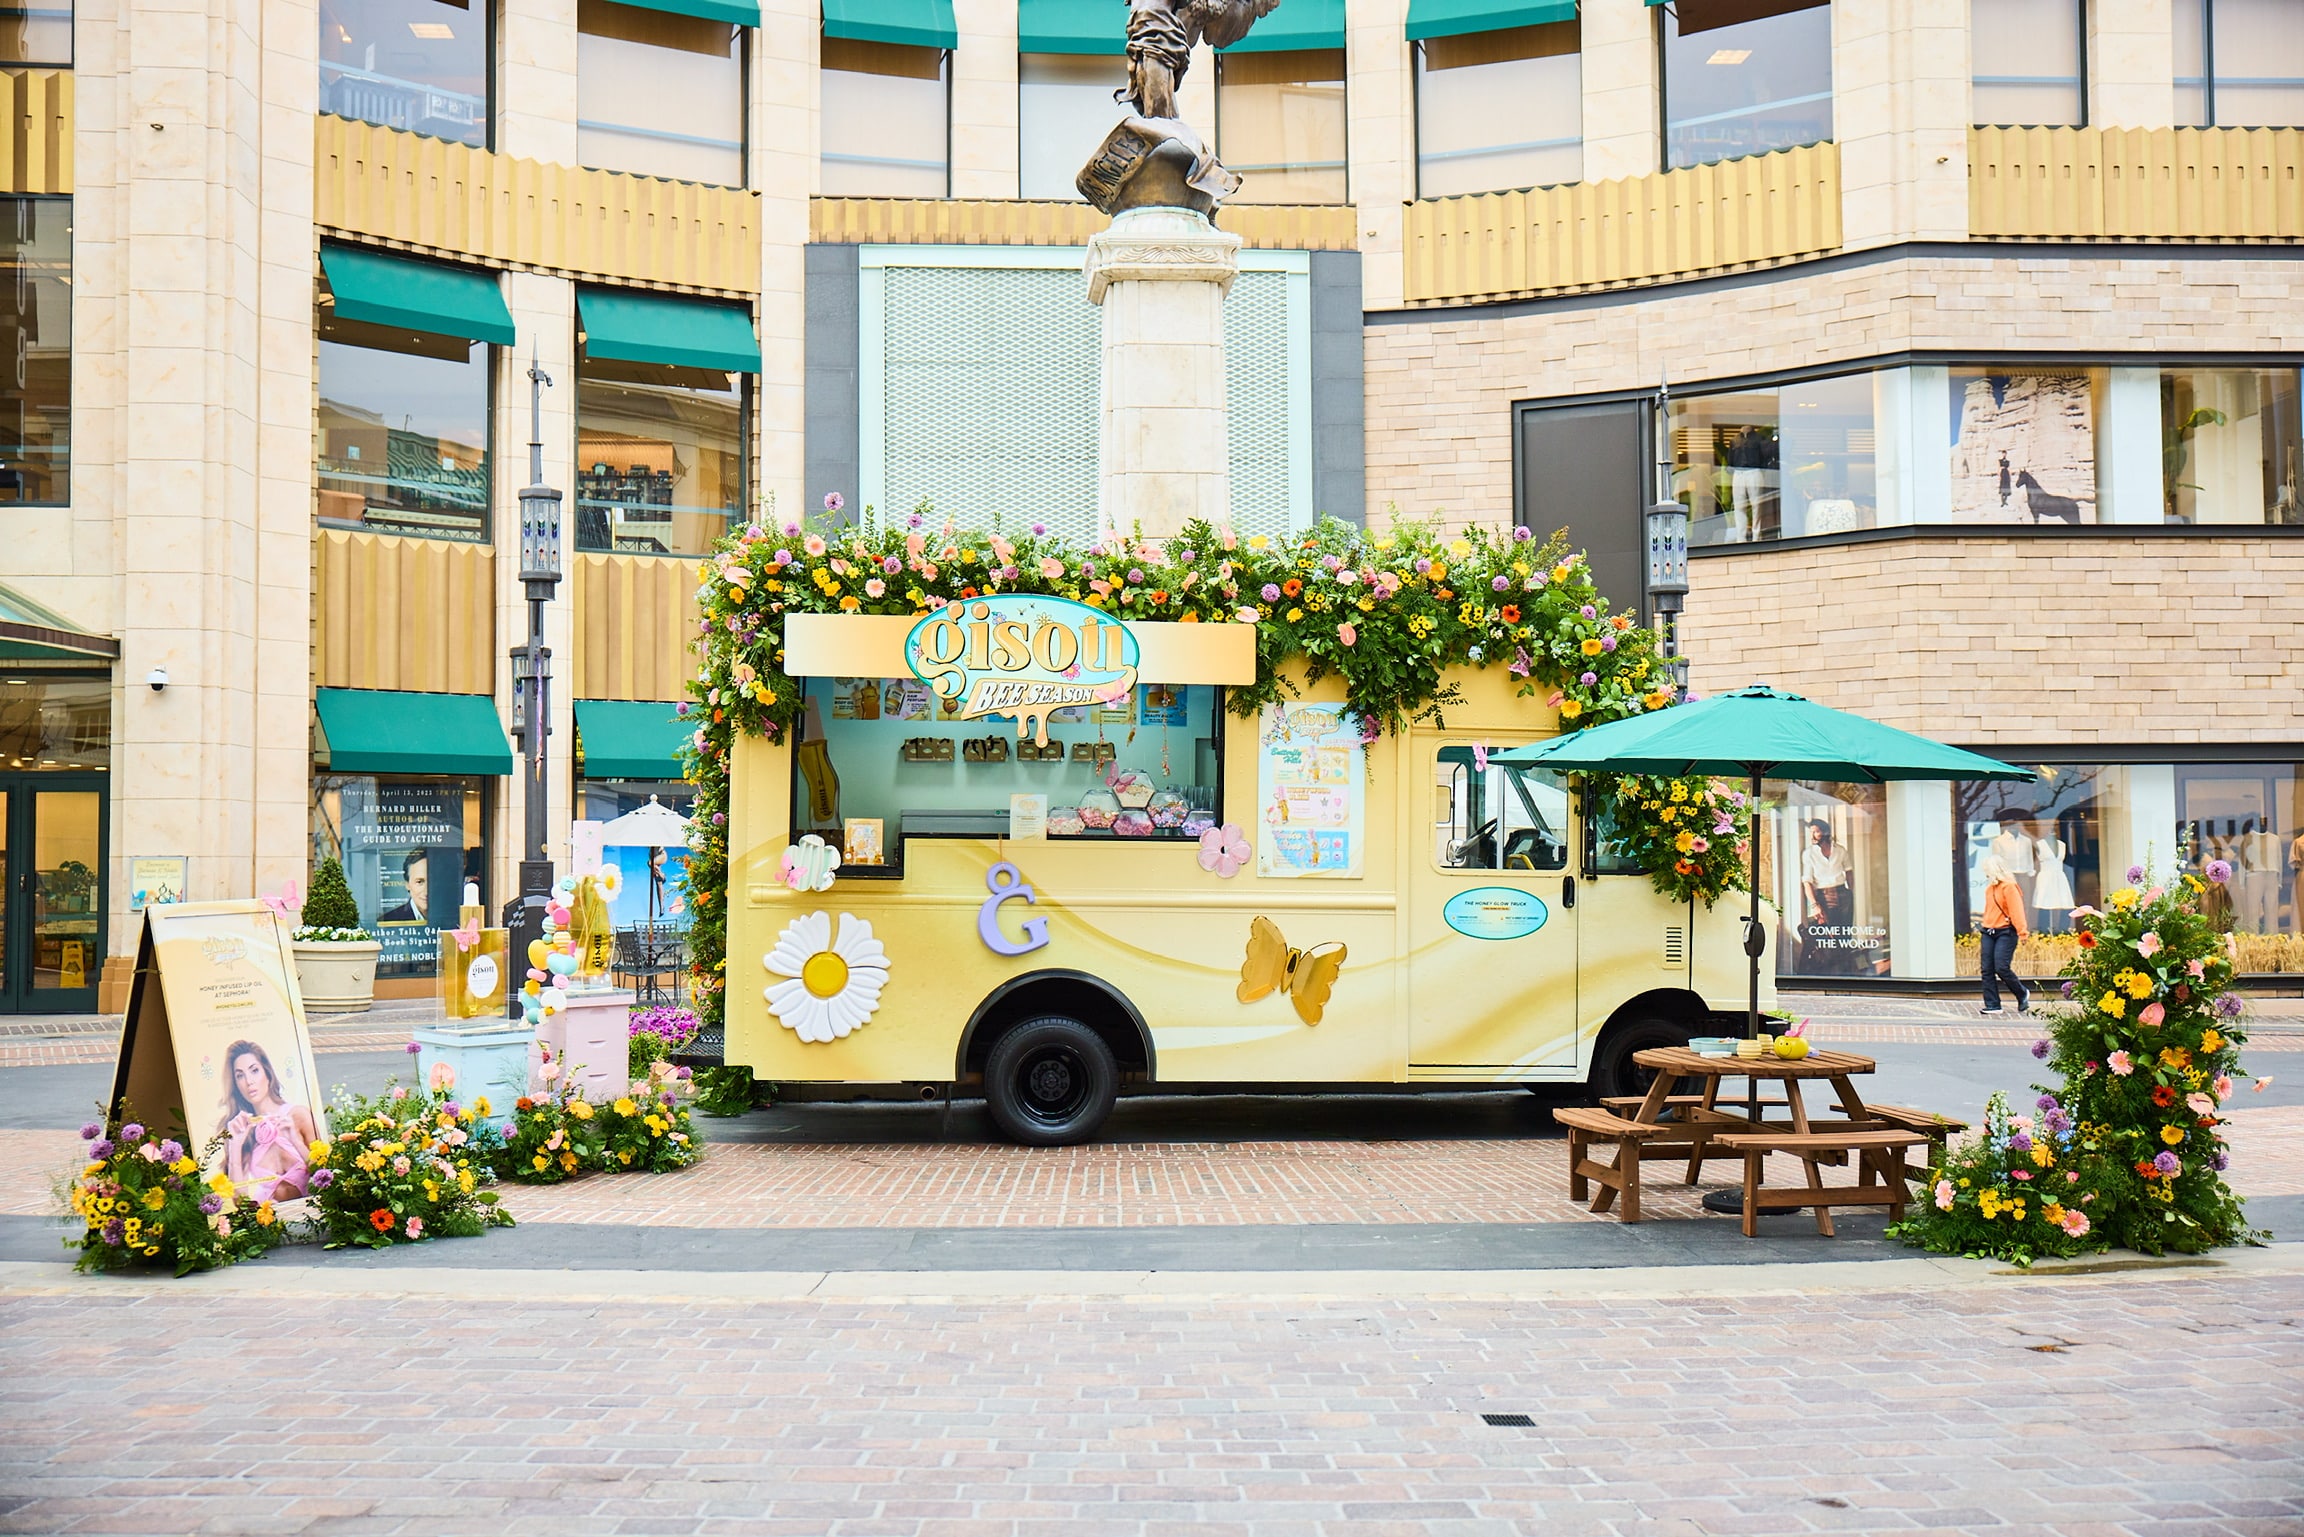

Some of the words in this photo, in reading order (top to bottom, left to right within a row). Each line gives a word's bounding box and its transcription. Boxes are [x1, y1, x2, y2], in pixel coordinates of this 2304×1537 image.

[916, 600, 1138, 699] gisou
[971, 680, 1030, 713] BEE
[1027, 683, 1096, 705] SEASON
[342, 789, 379, 797] Thursday,
[381, 789, 400, 797] April
[363, 805, 406, 813] BERNARD
[409, 805, 442, 813] HILLER
[377, 815, 414, 823] AUTHOR
[417, 815, 429, 823] OF
[354, 825, 373, 833] THE
[376, 824, 451, 833] REVOLUTIONARY
[362, 834, 392, 843] GUIDE
[394, 834, 407, 843] TO
[410, 834, 443, 843] ACTING
[367, 928, 396, 936] uthor
[1808, 925, 1841, 936] COME
[1842, 925, 1875, 936] HOME
[1876, 927, 1887, 936] to
[385, 938, 406, 946] Book
[1815, 939, 1838, 949] THE
[1838, 939, 1880, 949] WORLD
[592, 935, 605, 967] gisou
[472, 964, 495, 978] gisou
[199, 984, 218, 992] HONEY
